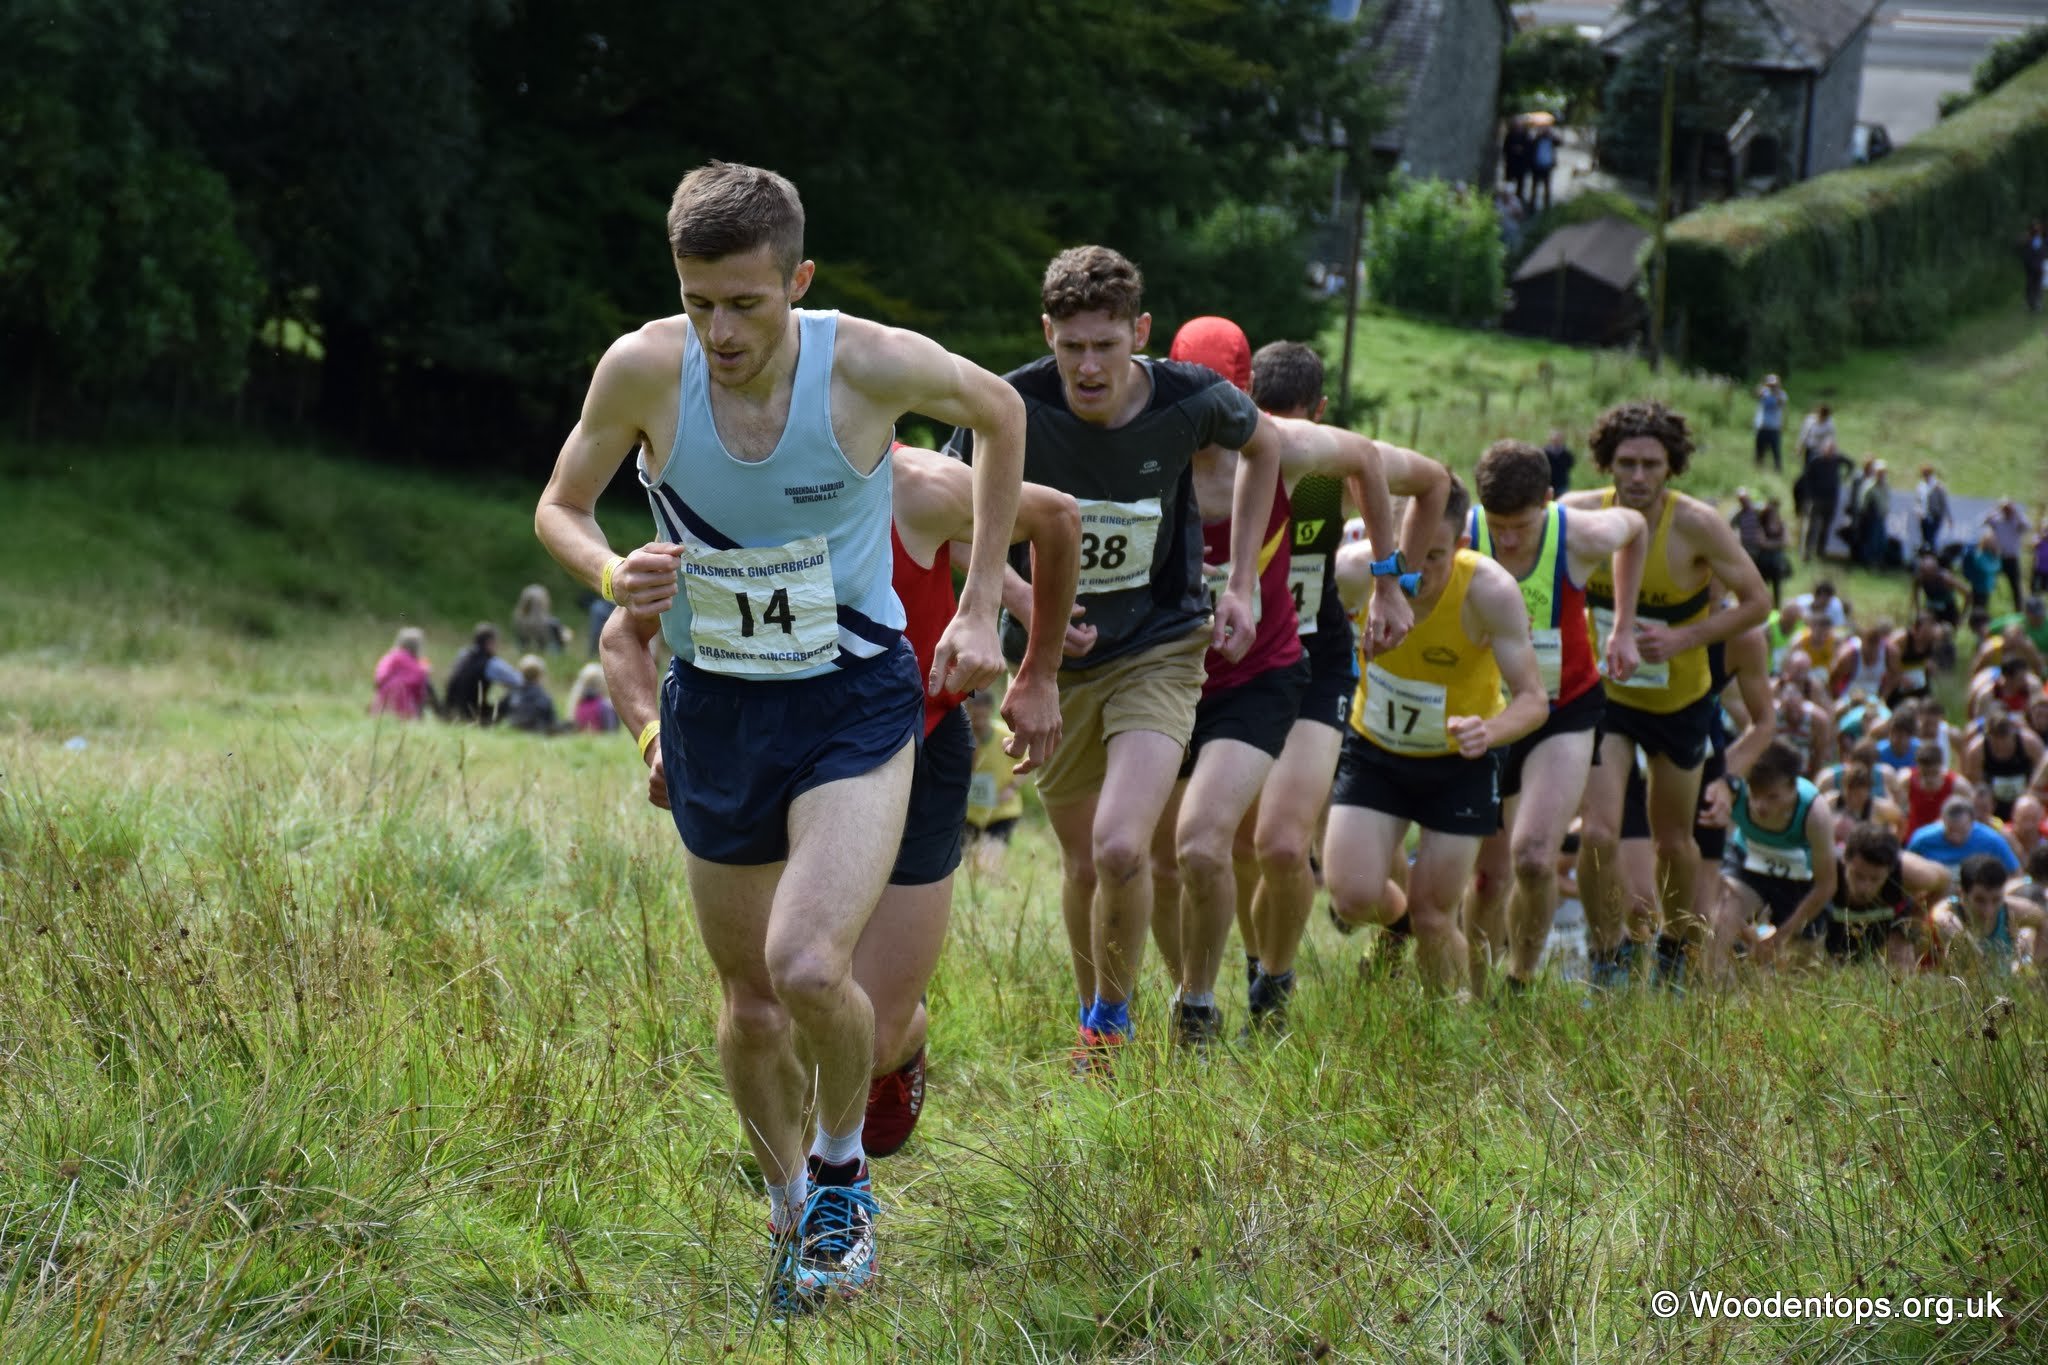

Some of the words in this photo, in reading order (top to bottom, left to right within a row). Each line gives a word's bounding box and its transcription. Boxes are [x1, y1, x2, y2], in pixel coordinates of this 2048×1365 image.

[784, 485, 819, 496] ROSSENDALE
[820, 480, 845, 492] HARRIERS
[792, 494, 823, 504] TRIATHLON
[686, 562, 745, 578] GRASMERE
[748, 554, 824, 578] GINGERBREAD
[1080, 532, 1128, 570] 38
[735, 587, 796, 638] 14
[1388, 699, 1420, 735] 17
